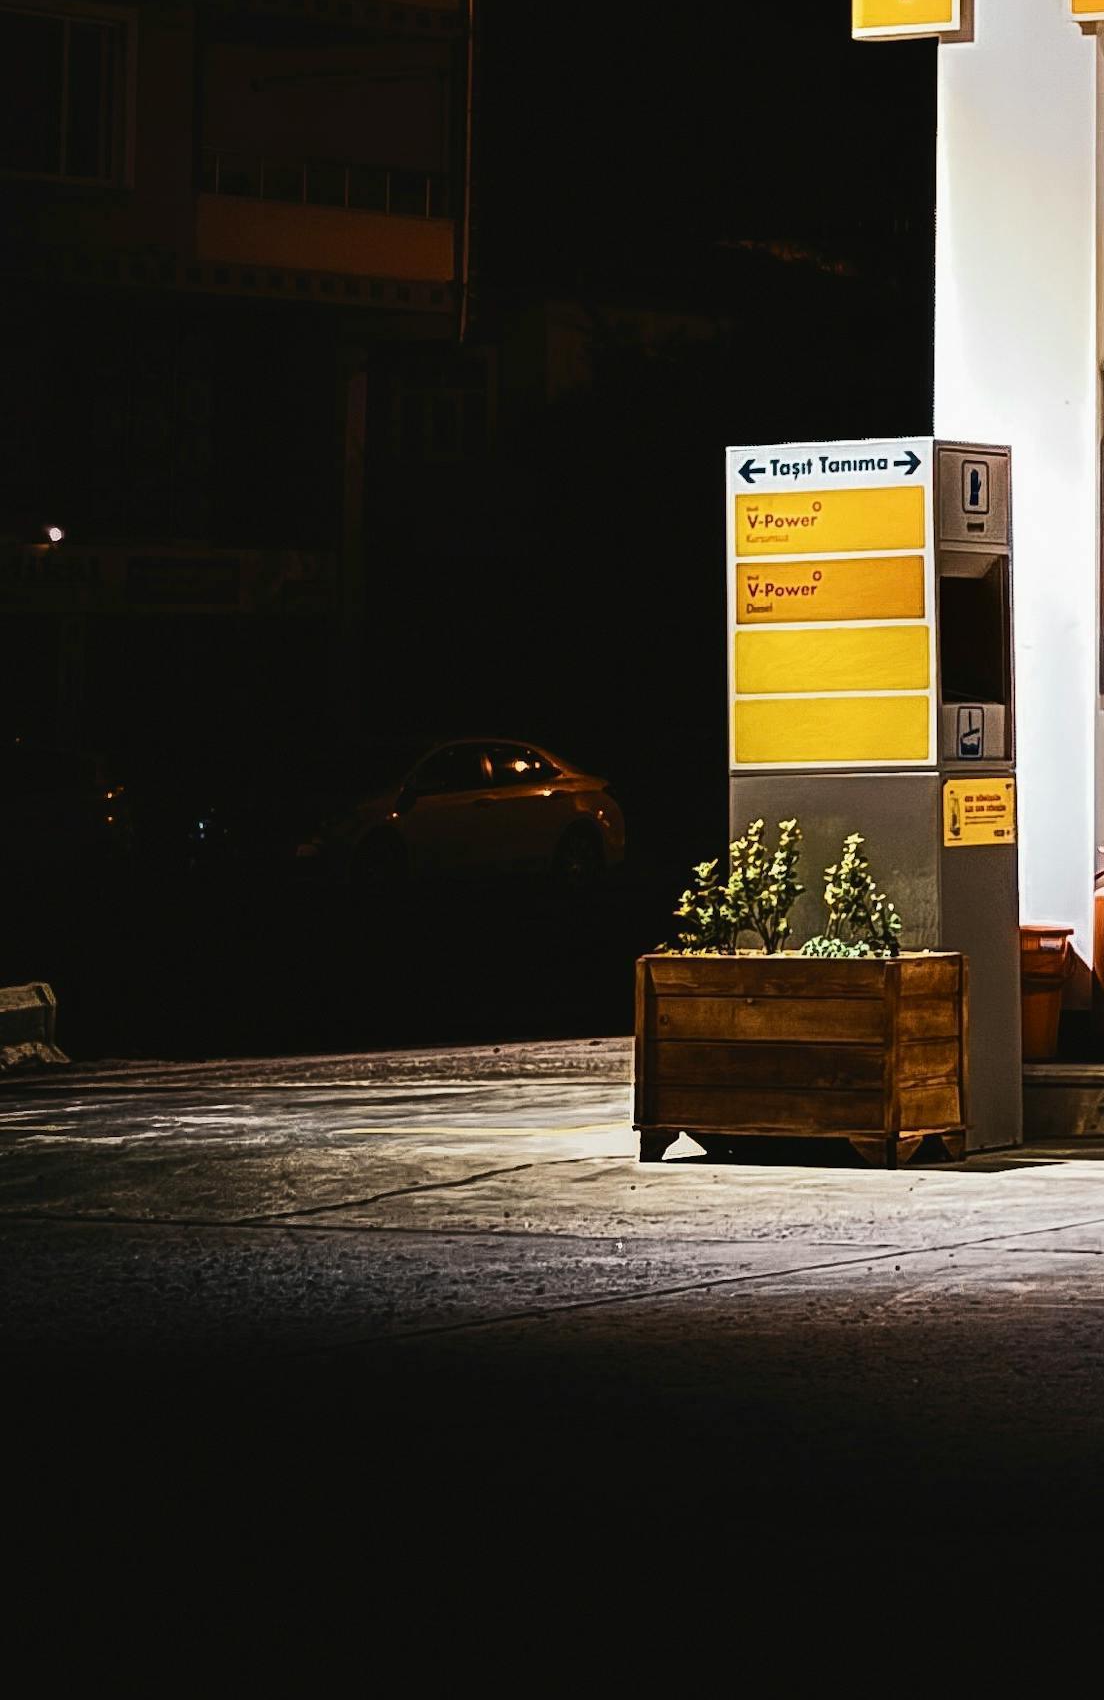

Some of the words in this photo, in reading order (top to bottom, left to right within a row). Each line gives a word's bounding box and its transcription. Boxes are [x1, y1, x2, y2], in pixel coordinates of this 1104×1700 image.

[769, 458, 813, 480] Taşıt
[818, 456, 889, 473] Tanıma
[747, 514, 818, 529] V-Power
[747, 583, 818, 598] V-Power
